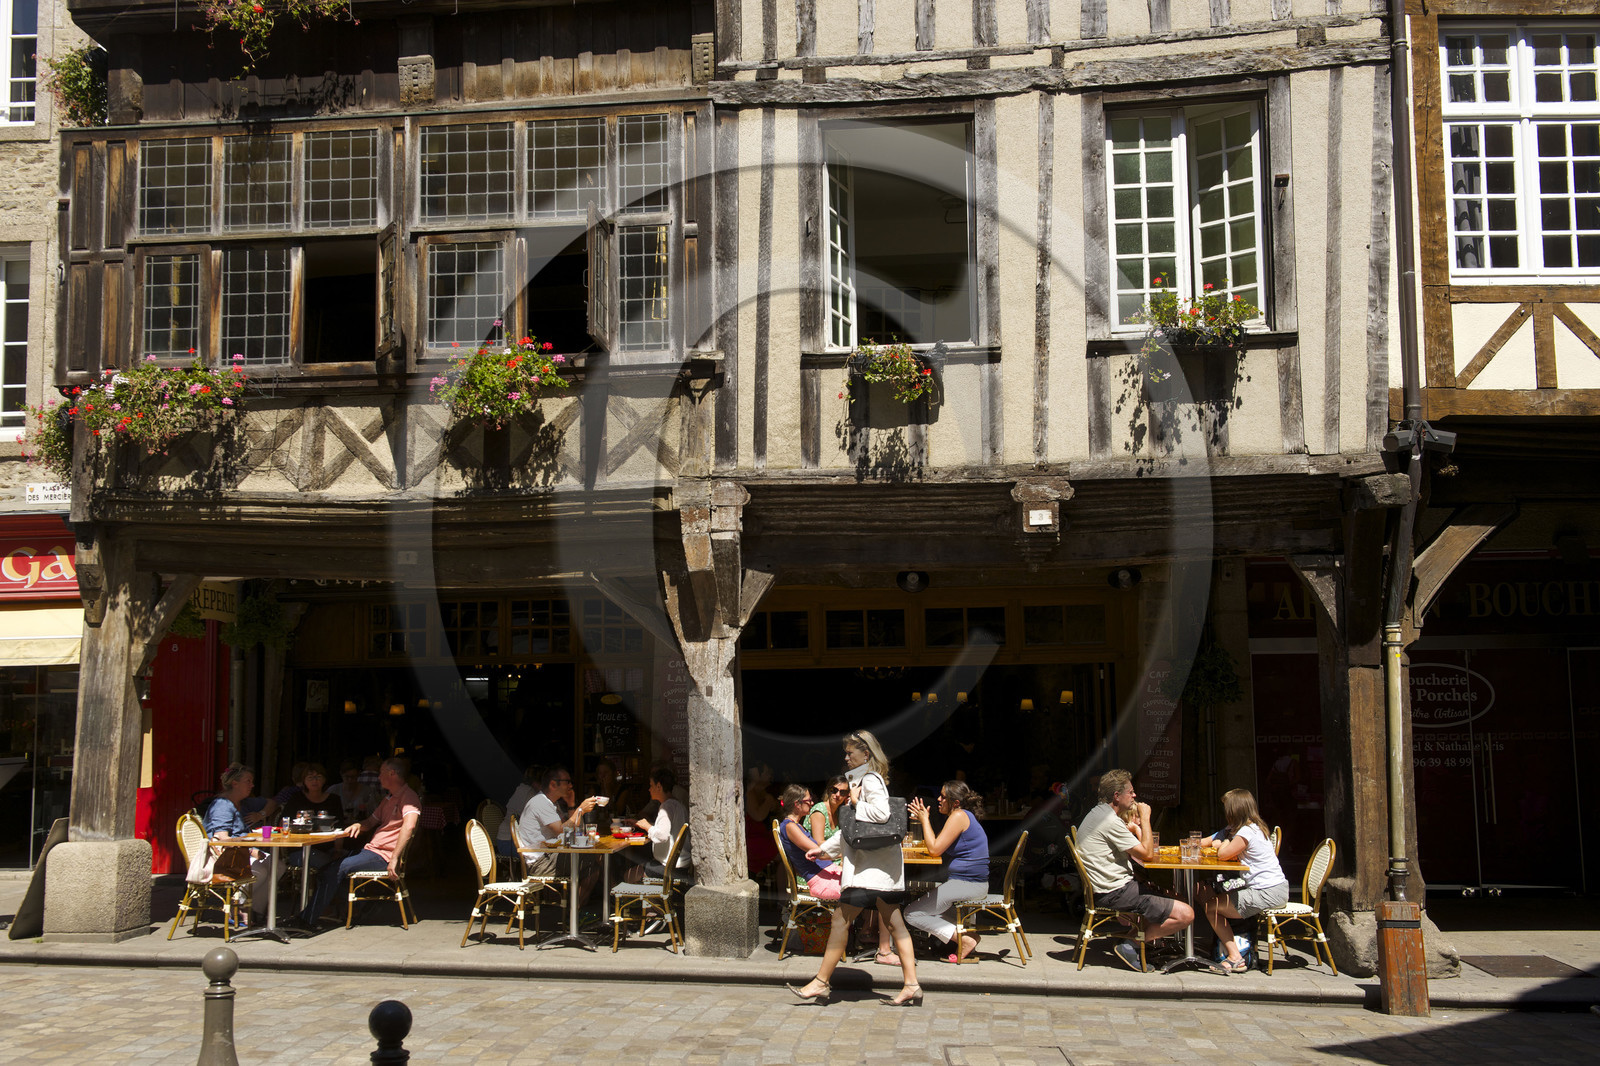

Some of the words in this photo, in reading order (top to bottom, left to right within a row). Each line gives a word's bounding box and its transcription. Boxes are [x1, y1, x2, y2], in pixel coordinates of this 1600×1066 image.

[1466, 581, 1600, 617] BOUCH
[172, 643, 179, 652] 8
[1415, 687, 1478, 702] Porches
[1424, 742, 1435, 752] &
[1428, 757, 1441, 768] 39
[1444, 757, 1457, 768] 48
